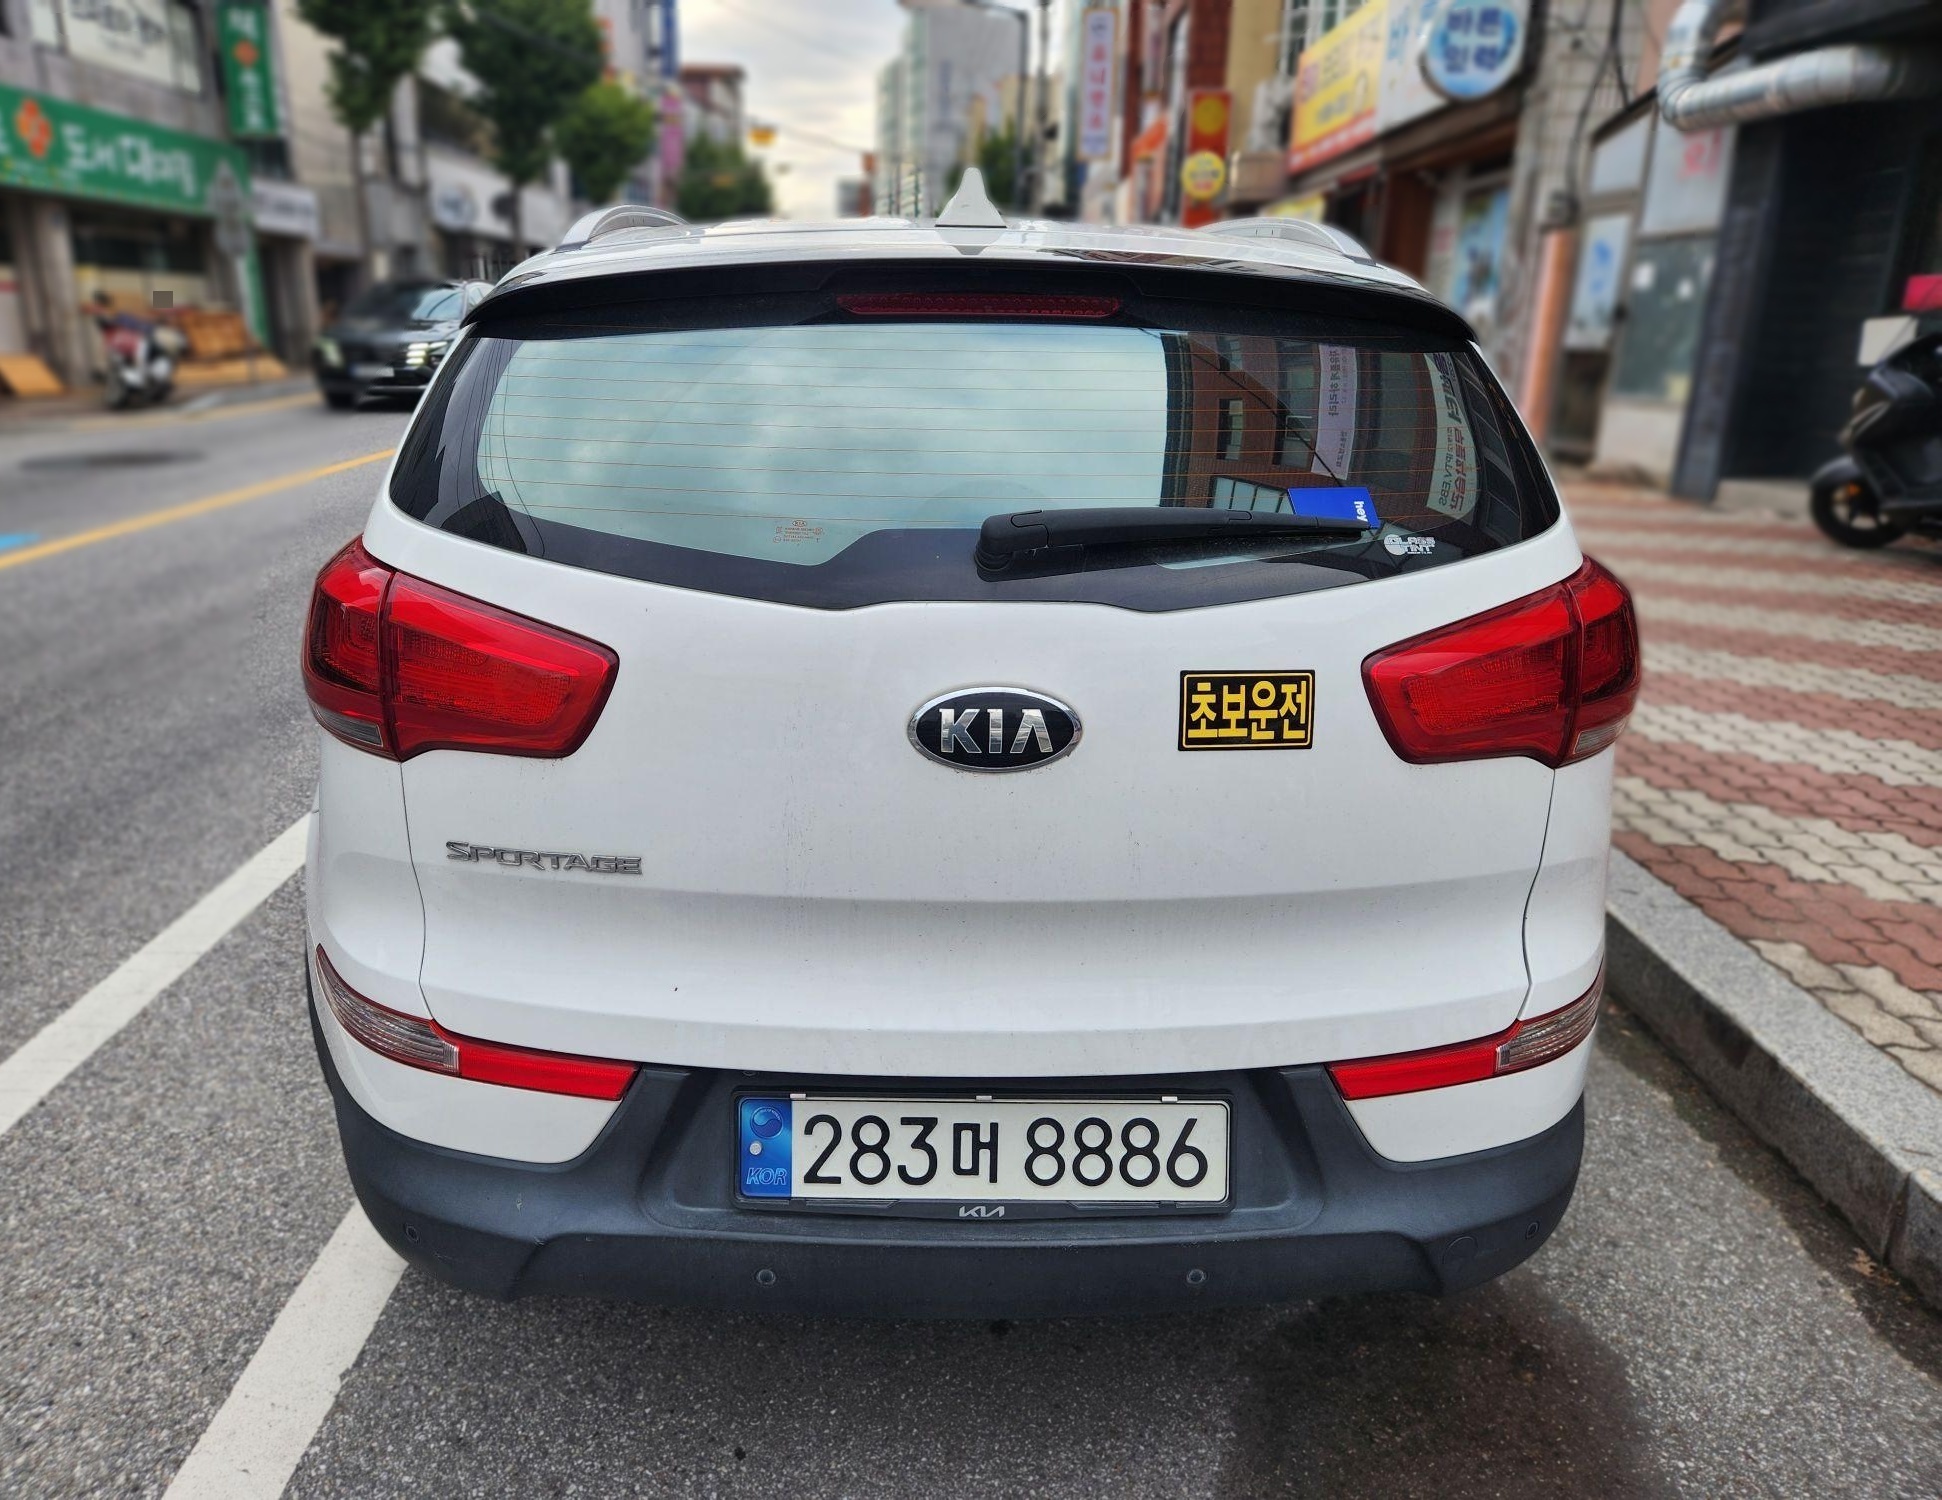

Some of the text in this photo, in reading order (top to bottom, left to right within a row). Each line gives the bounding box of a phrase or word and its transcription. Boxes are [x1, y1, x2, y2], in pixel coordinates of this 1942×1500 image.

[1353, 500, 1369, 522] hey
[1187, 680, 1308, 741] 초보운전
[938, 708, 1054, 753] KIA
[445, 841, 643, 875] SPORTAGE
[803, 1113, 1209, 1188] 283머 8886
[746, 1166, 787, 1186] KOR
